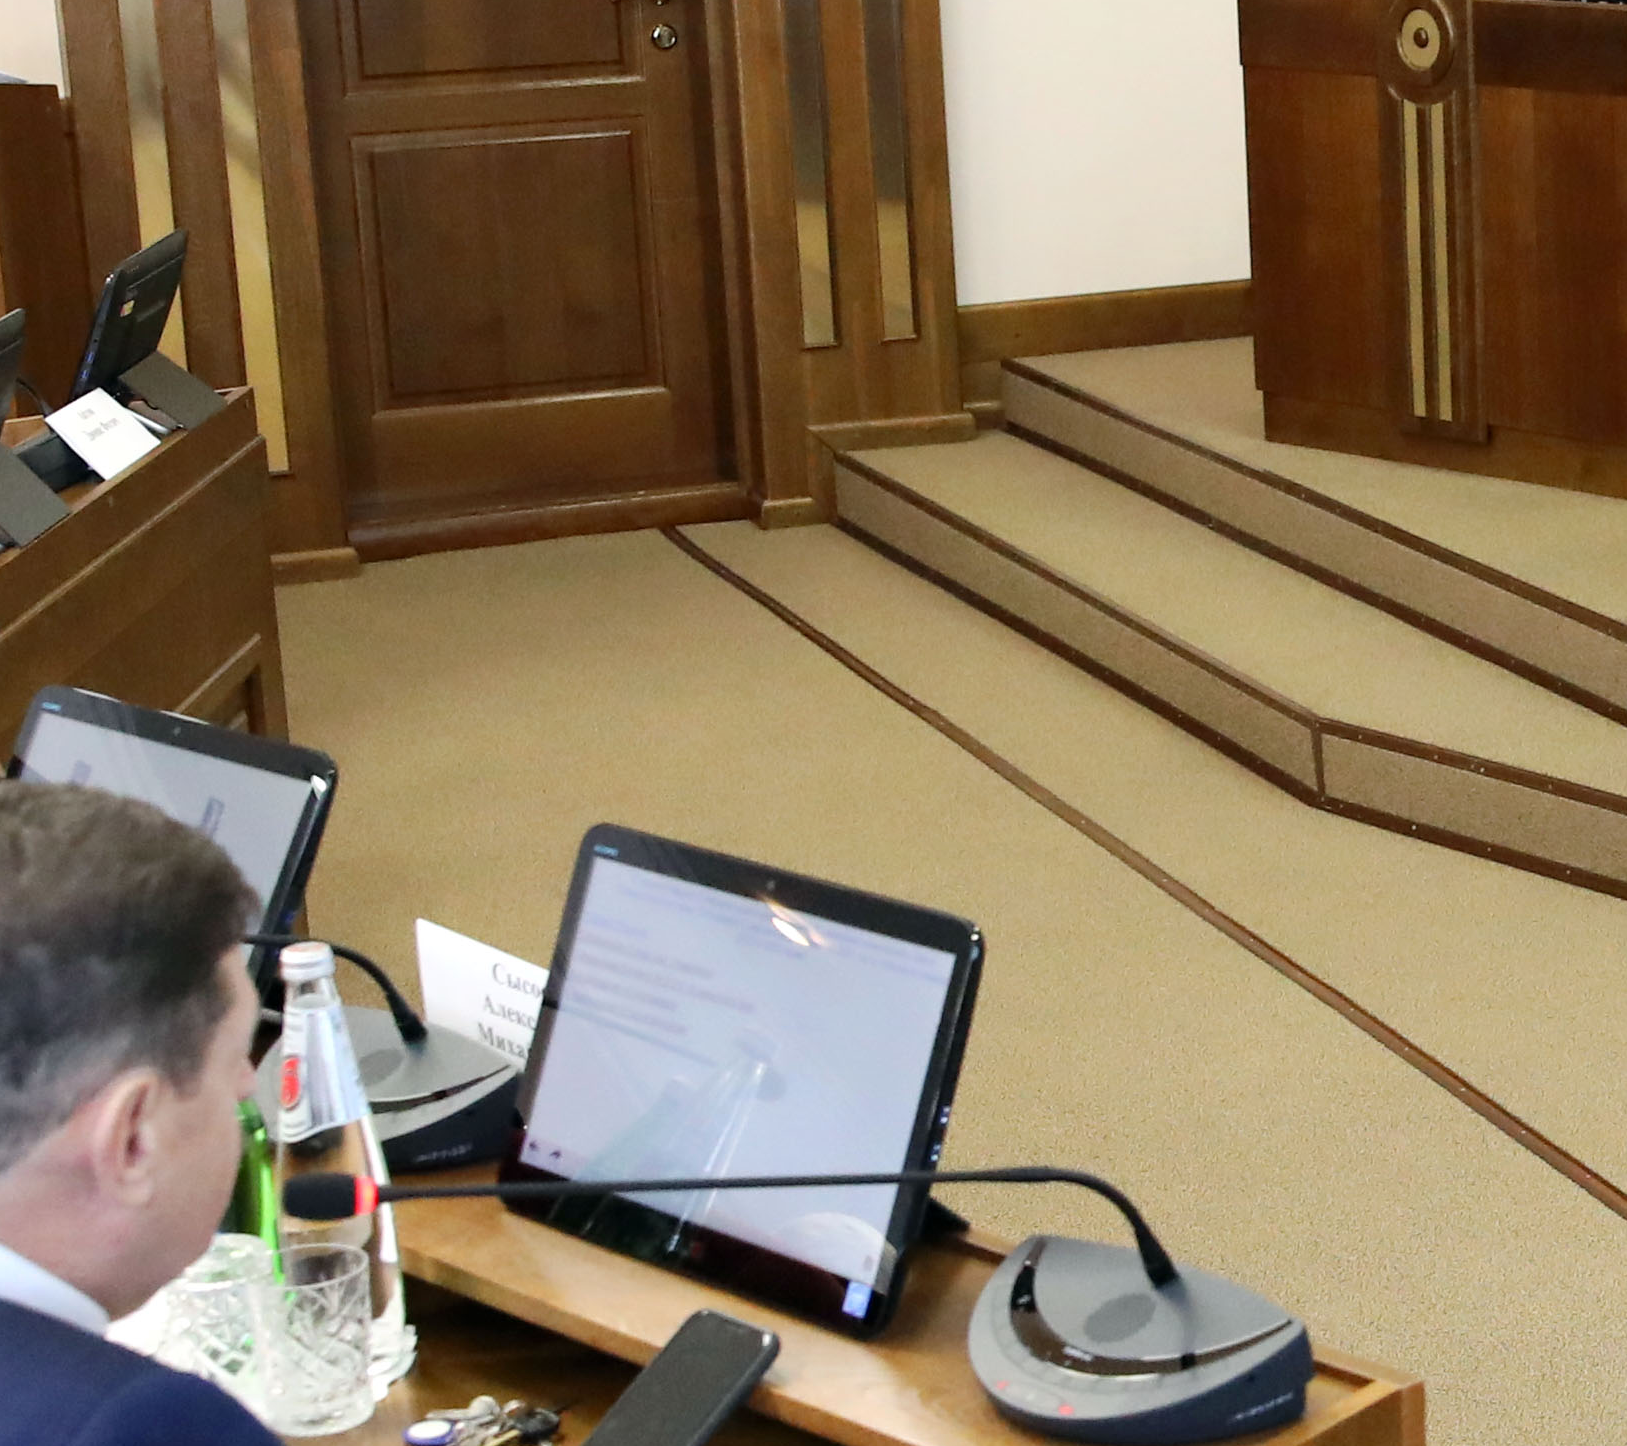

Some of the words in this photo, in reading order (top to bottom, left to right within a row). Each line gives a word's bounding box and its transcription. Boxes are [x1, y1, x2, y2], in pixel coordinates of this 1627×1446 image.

[491, 962, 543, 999] Сысо
[482, 994, 536, 1030] Алекс
[478, 1021, 529, 1061] Миха
